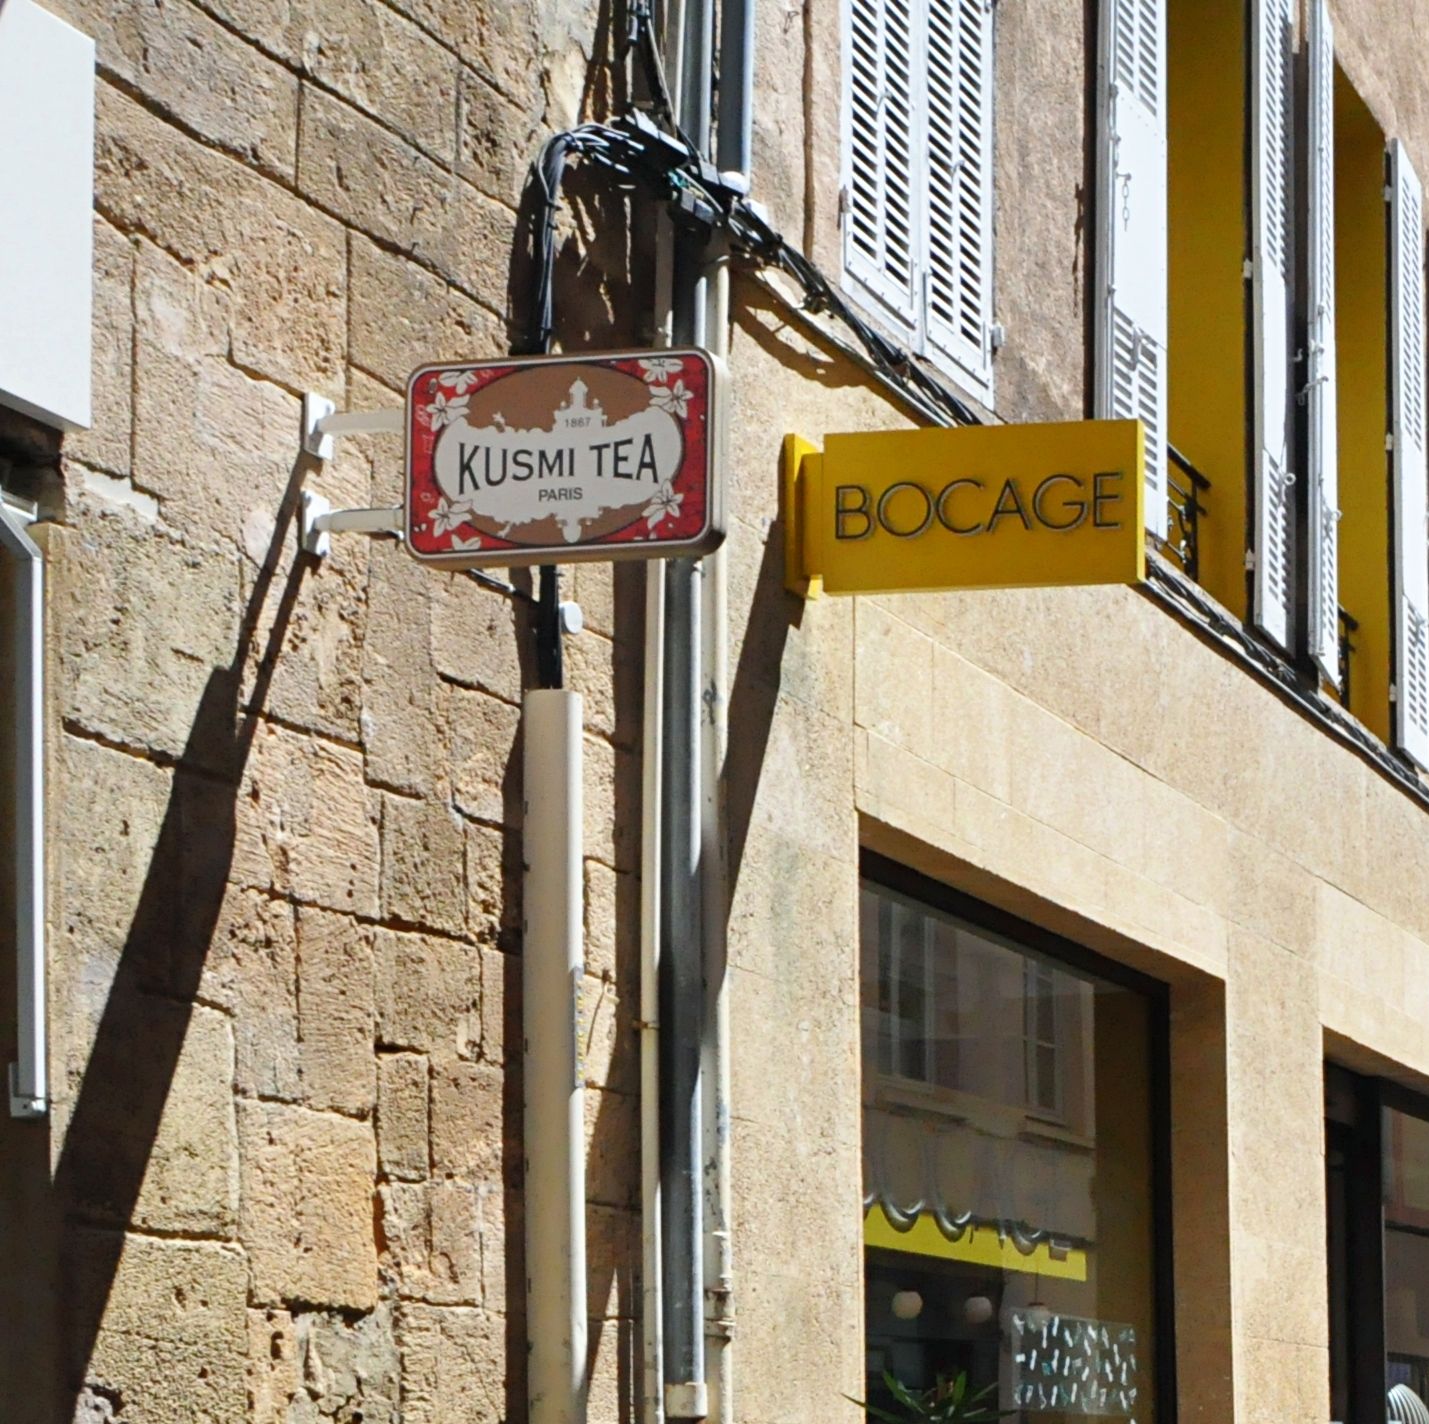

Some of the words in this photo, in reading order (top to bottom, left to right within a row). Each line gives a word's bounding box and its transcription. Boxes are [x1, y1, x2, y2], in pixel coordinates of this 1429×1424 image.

[458, 442, 576, 495] KUSMI
[589, 433, 660, 484] TEA
[537, 487, 584, 503] PARIS
[835, 471, 1124, 541] BOCAGE
